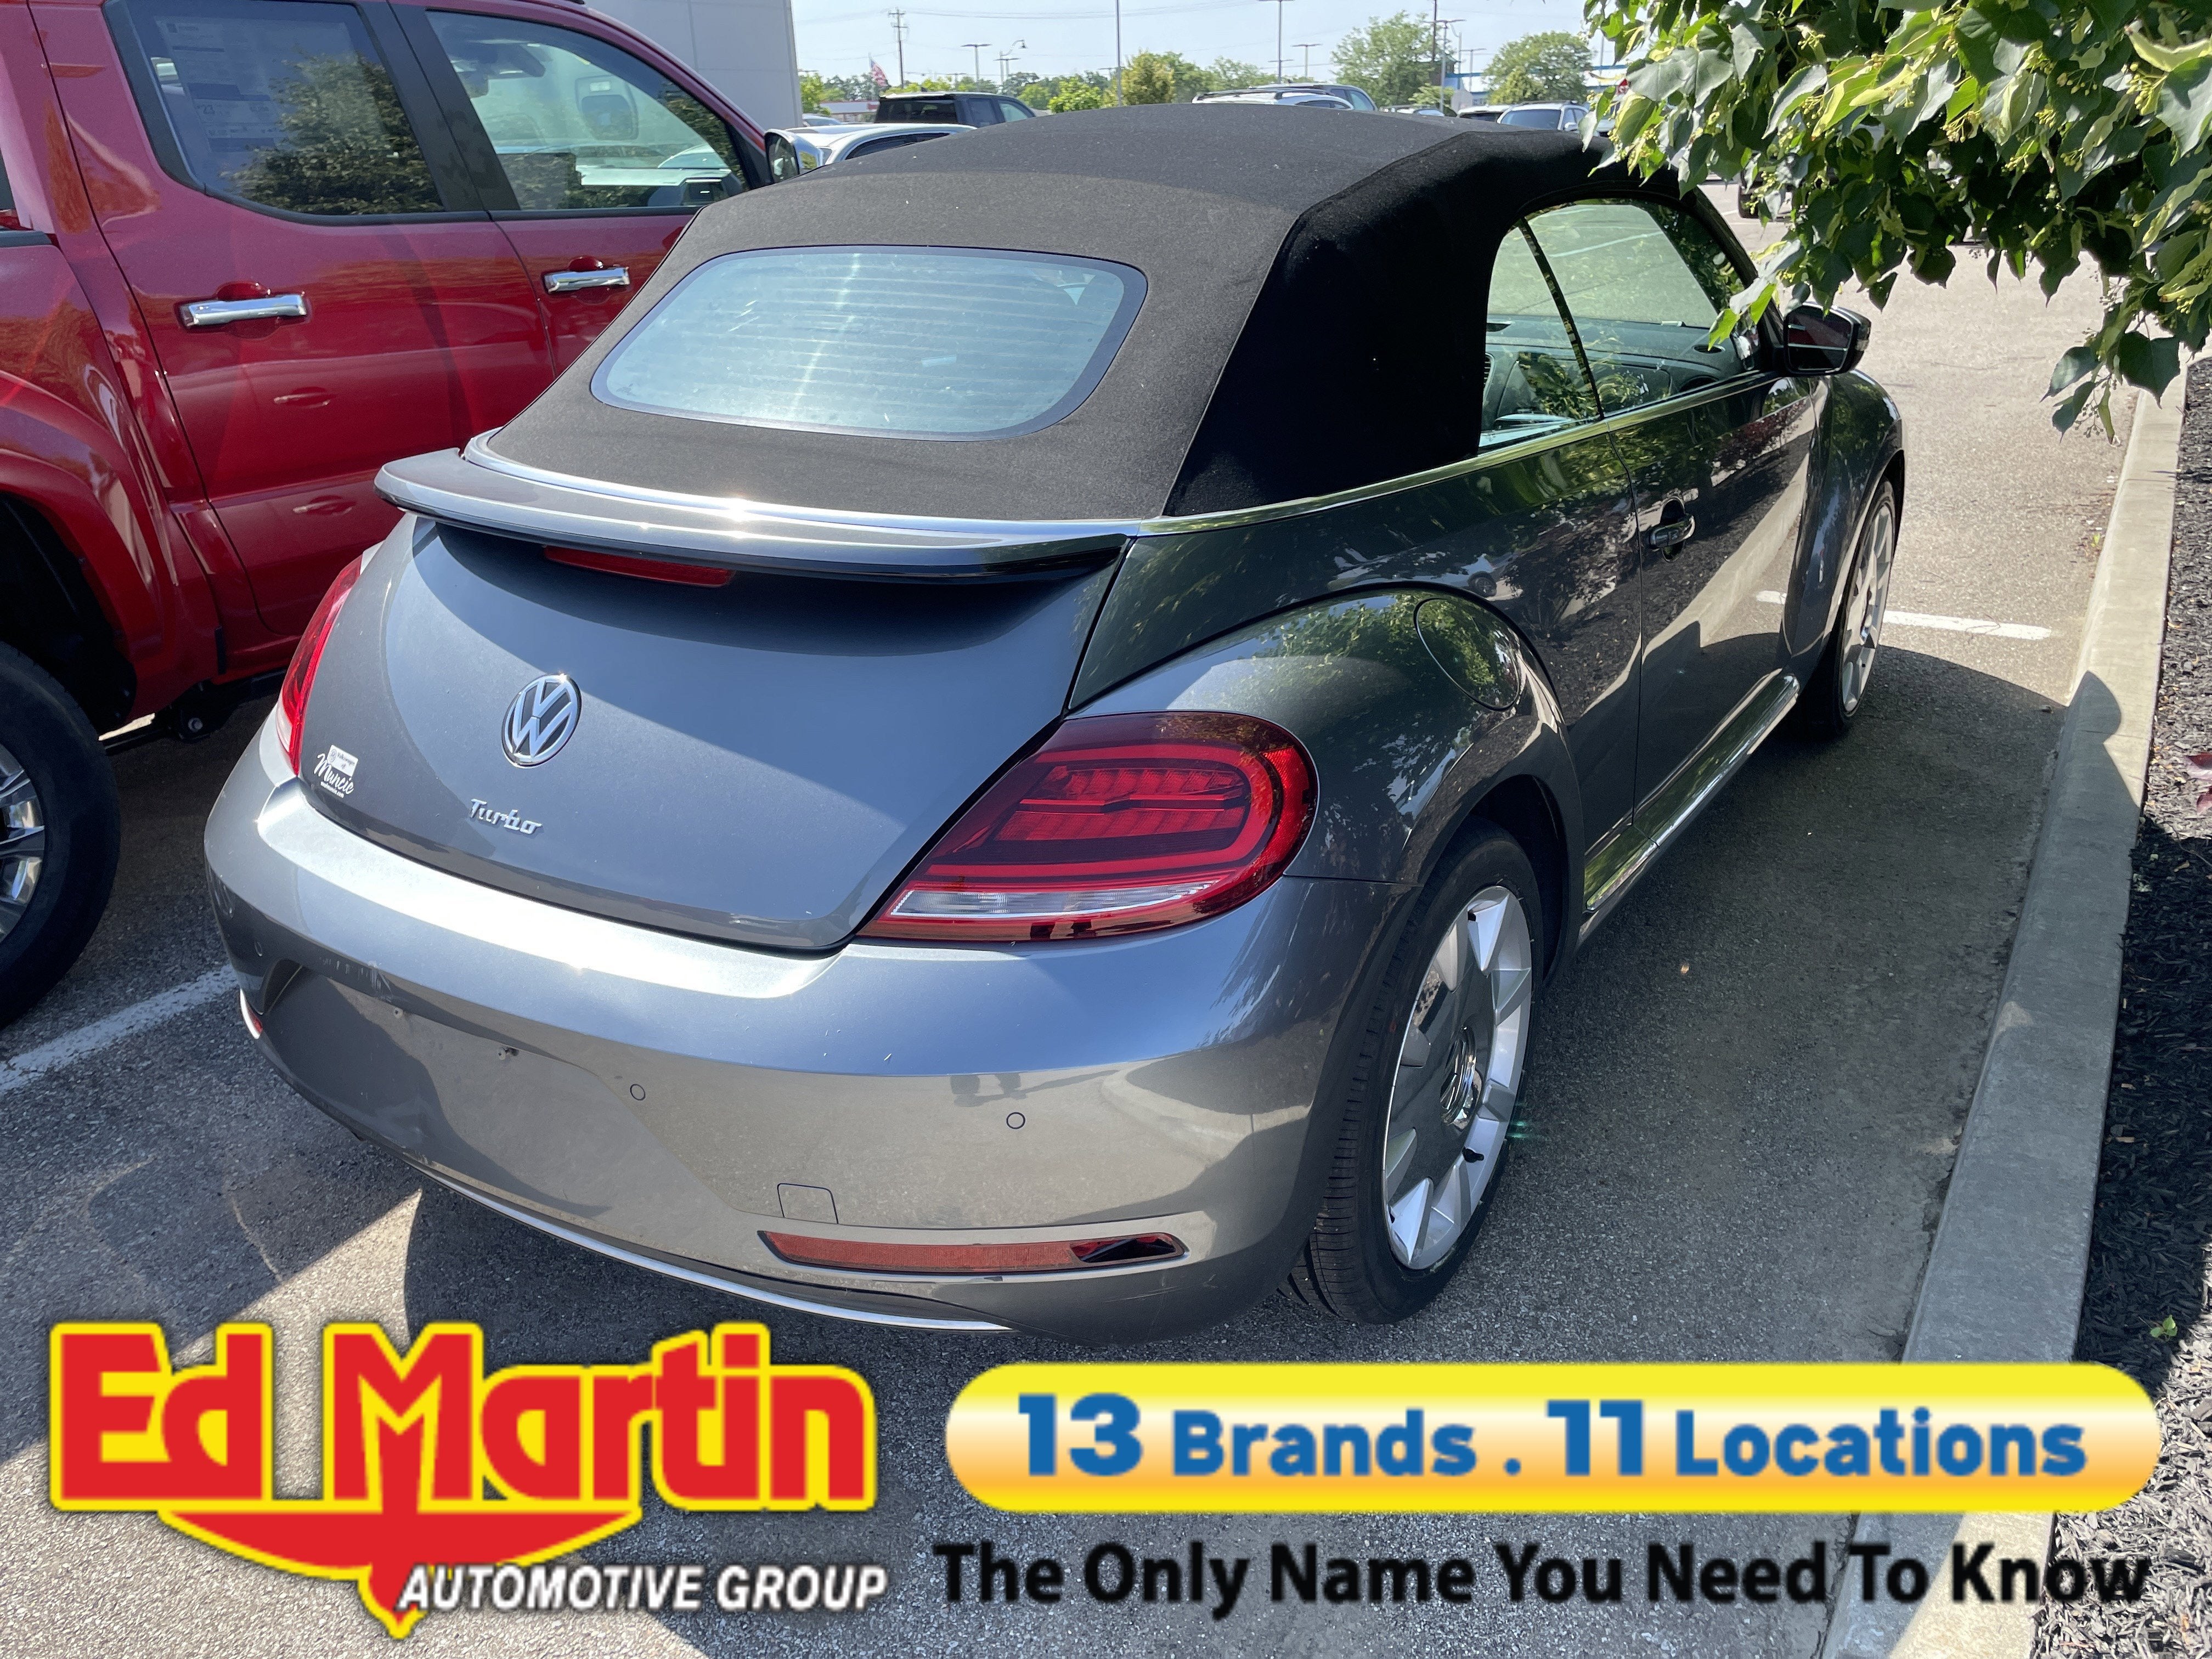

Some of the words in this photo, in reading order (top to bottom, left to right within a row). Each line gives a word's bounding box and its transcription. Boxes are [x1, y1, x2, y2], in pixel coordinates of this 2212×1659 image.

[504, 675, 579, 763] VW
[313, 753, 354, 795] Muncie
[470, 798, 543, 834] Turbo
